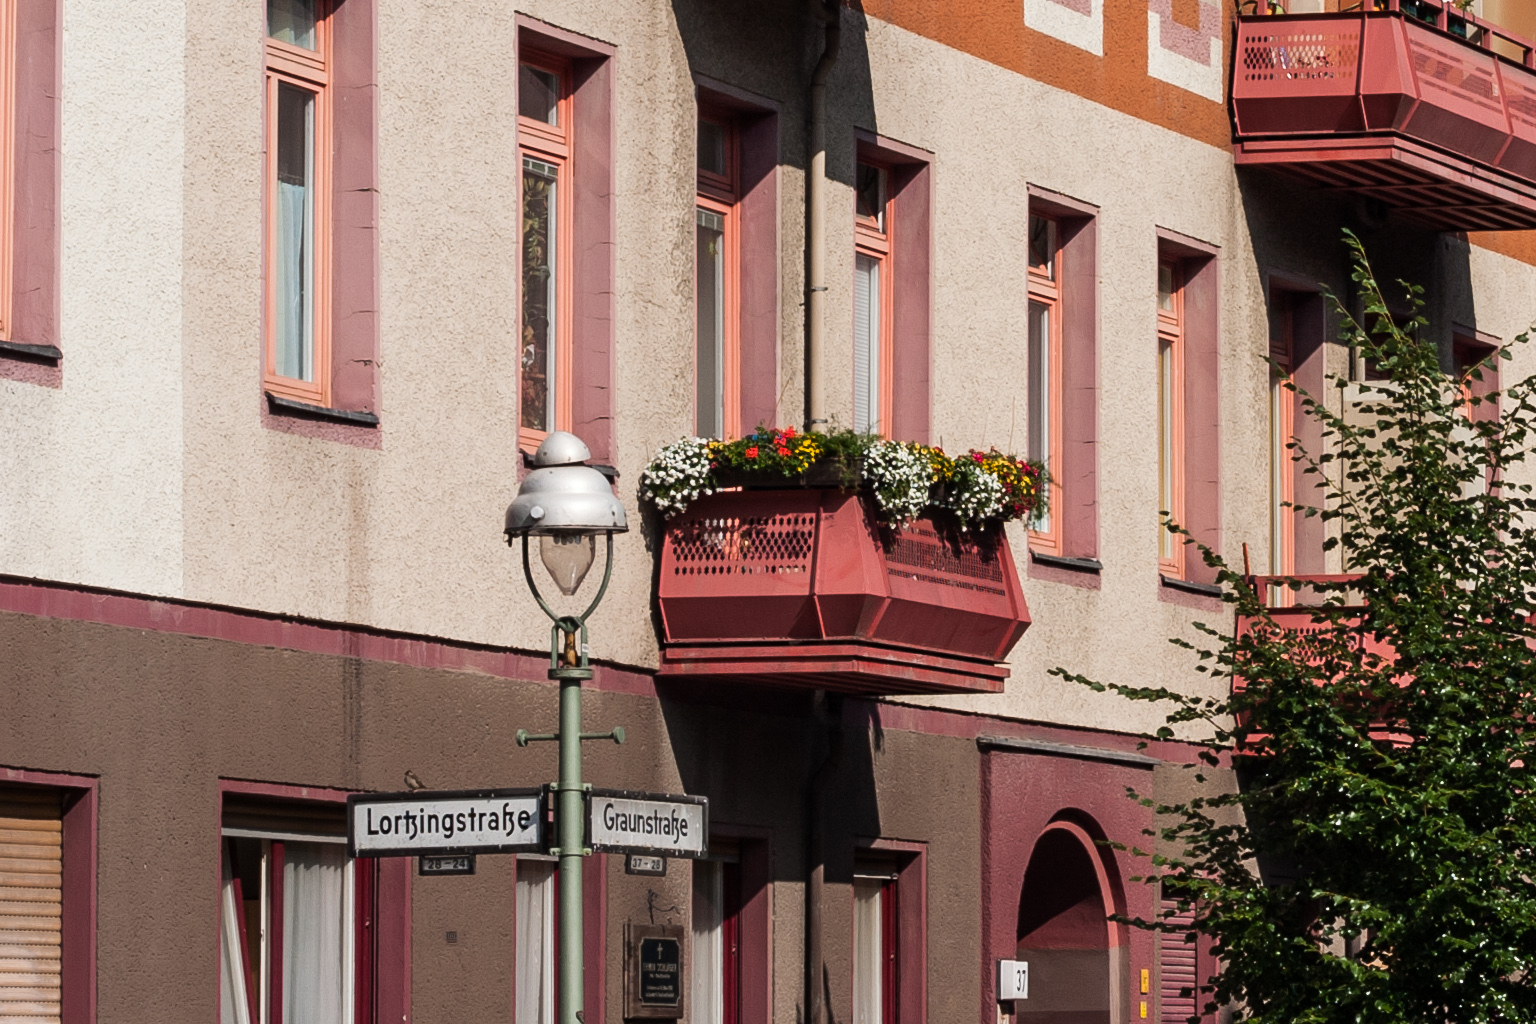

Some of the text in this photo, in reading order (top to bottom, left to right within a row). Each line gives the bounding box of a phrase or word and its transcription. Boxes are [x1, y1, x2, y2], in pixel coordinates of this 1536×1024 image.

[367, 803, 531, 840] Lortzingstraße
[603, 803, 689, 843] Graunstraße
[452, 858, 466, 869] 24
[632, 858, 643, 868] 37
[1016, 969, 1026, 993] 37
